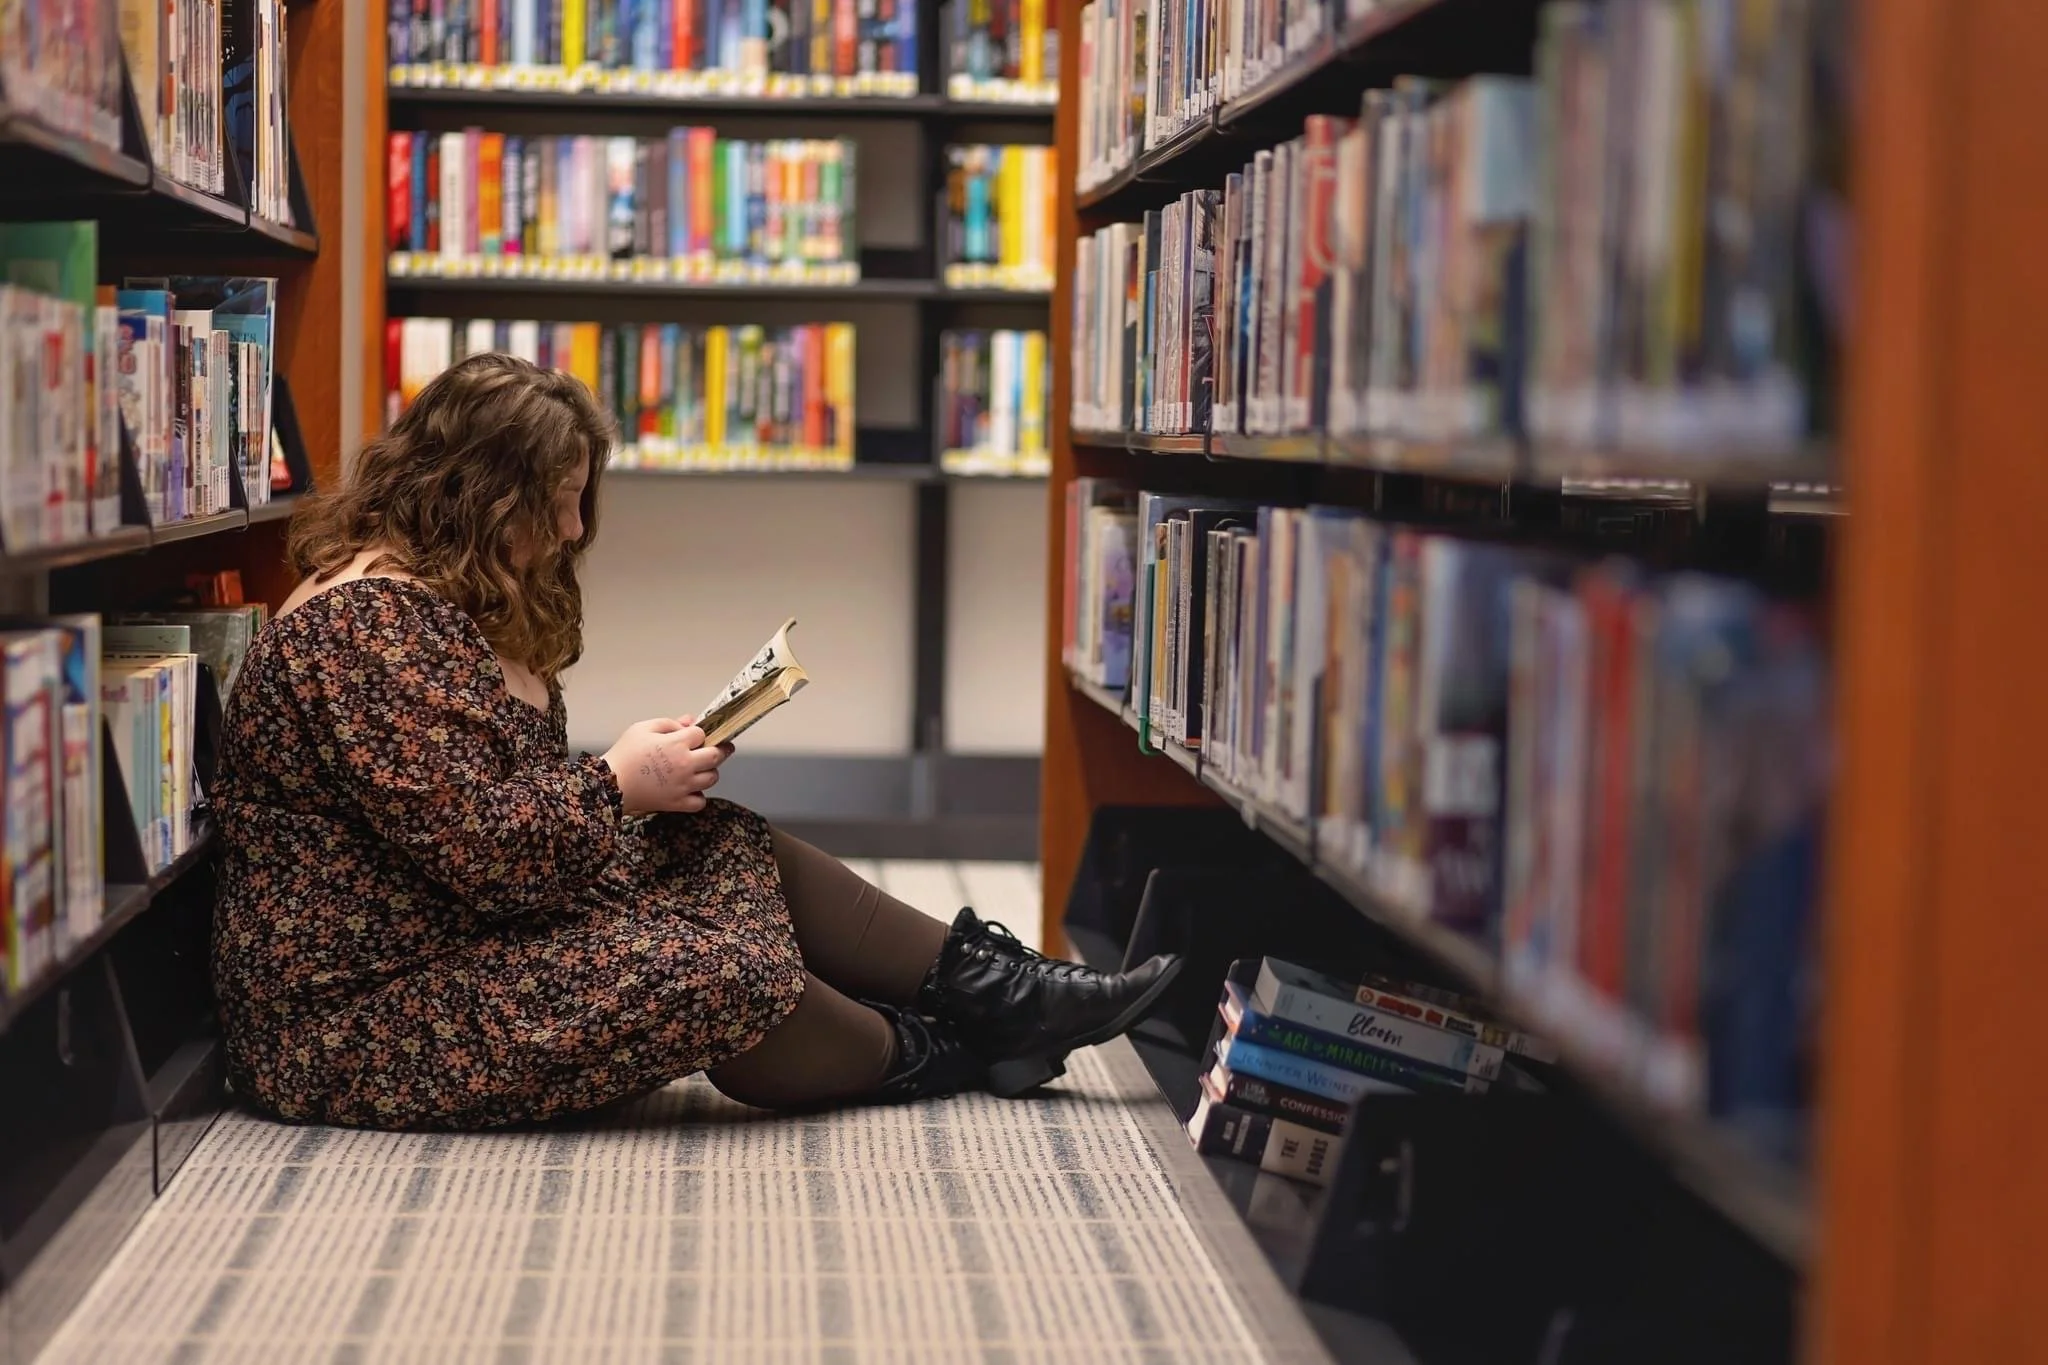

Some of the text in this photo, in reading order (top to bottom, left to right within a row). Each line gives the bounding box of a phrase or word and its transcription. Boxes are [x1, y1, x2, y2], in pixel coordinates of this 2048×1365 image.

[1347, 1012, 1403, 1048] Bloom
[1233, 1051, 1303, 1080] JENNIFER
[1282, 1031, 1310, 1051] AGE
[1325, 1043, 1399, 1076] MIRACLES
[1280, 1136, 1300, 1159] THE
[1305, 1137, 1329, 1176] BOOKS
